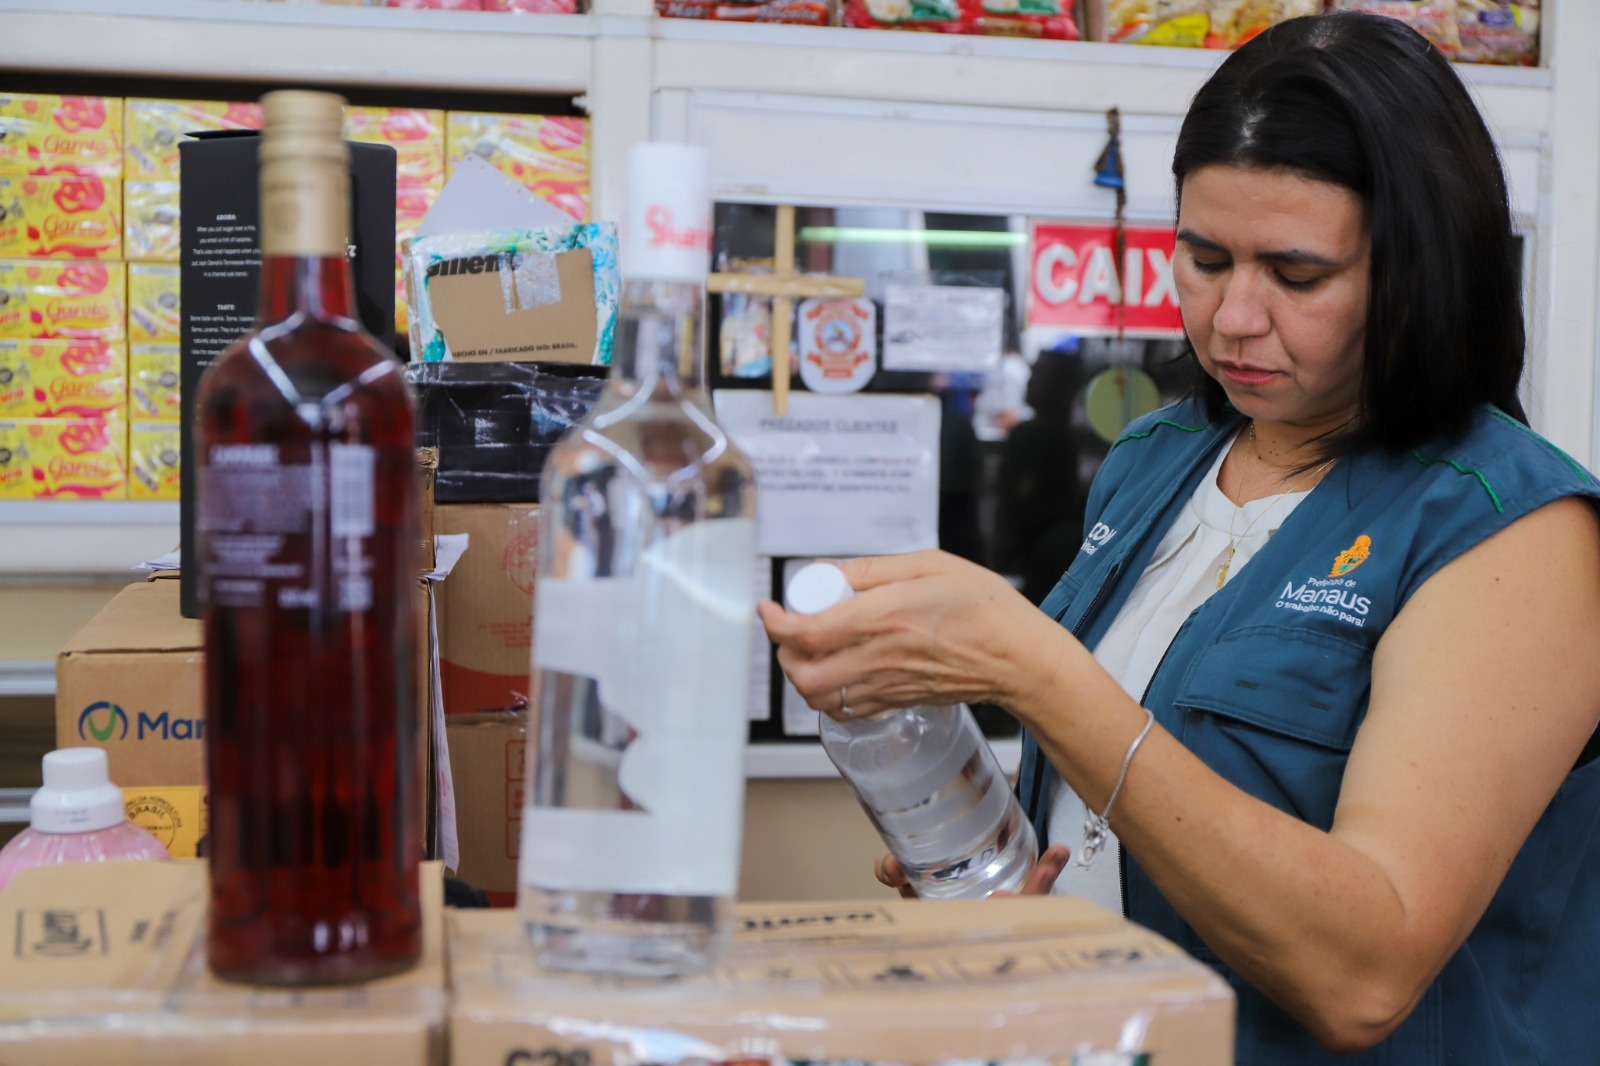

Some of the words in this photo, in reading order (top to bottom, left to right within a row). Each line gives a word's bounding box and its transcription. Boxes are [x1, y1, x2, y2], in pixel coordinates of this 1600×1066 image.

[451, 350, 477, 358] HECHO
[495, 344, 535, 354] FABRICADO
[1307, 577, 1344, 587] Prefeitura
[1344, 579, 1357, 588] de
[1280, 581, 1372, 615] Manaus
[1319, 605, 1339, 616] não
[1339, 611, 1366, 627] para!
[127, 805, 166, 820] BRASIL
